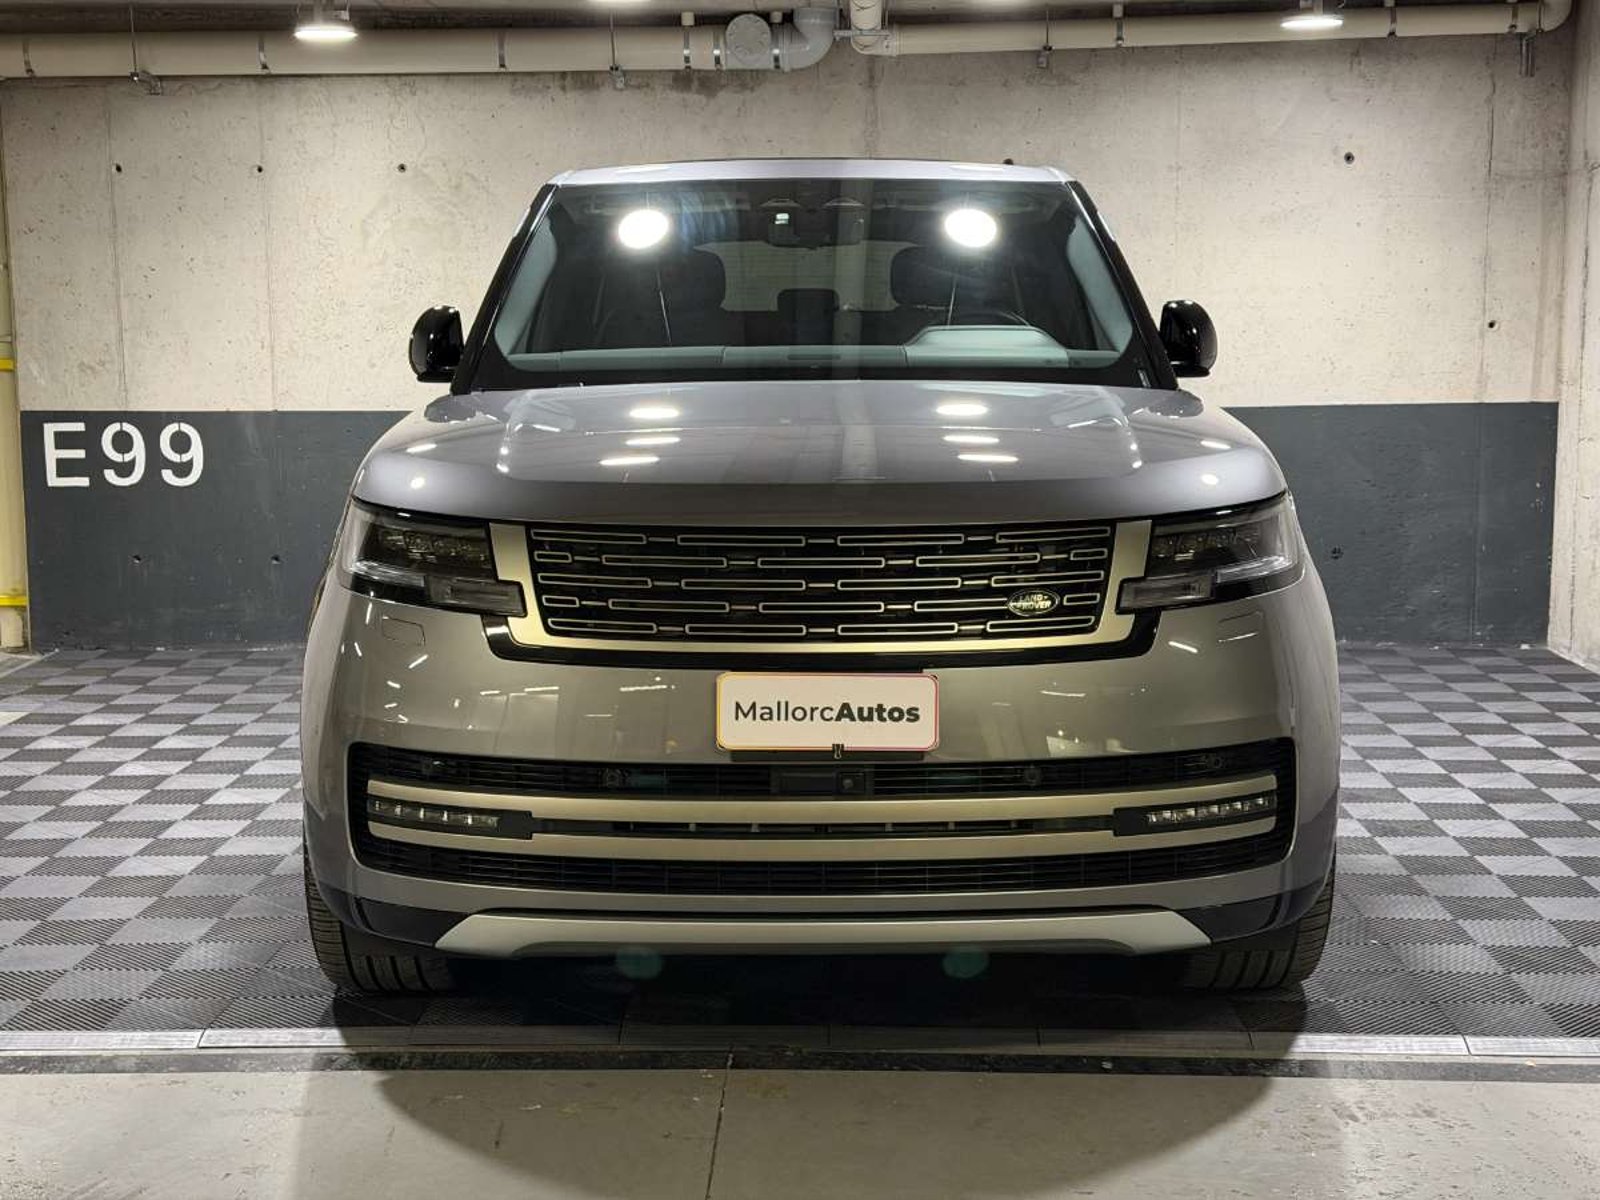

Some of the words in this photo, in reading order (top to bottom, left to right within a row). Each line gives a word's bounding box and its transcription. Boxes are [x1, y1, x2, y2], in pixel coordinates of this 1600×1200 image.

[43, 422, 204, 487] E99
[1019, 594, 1043, 602] LAND
[1021, 600, 1051, 610] ROVER
[734, 701, 920, 722] MallorcAutos
